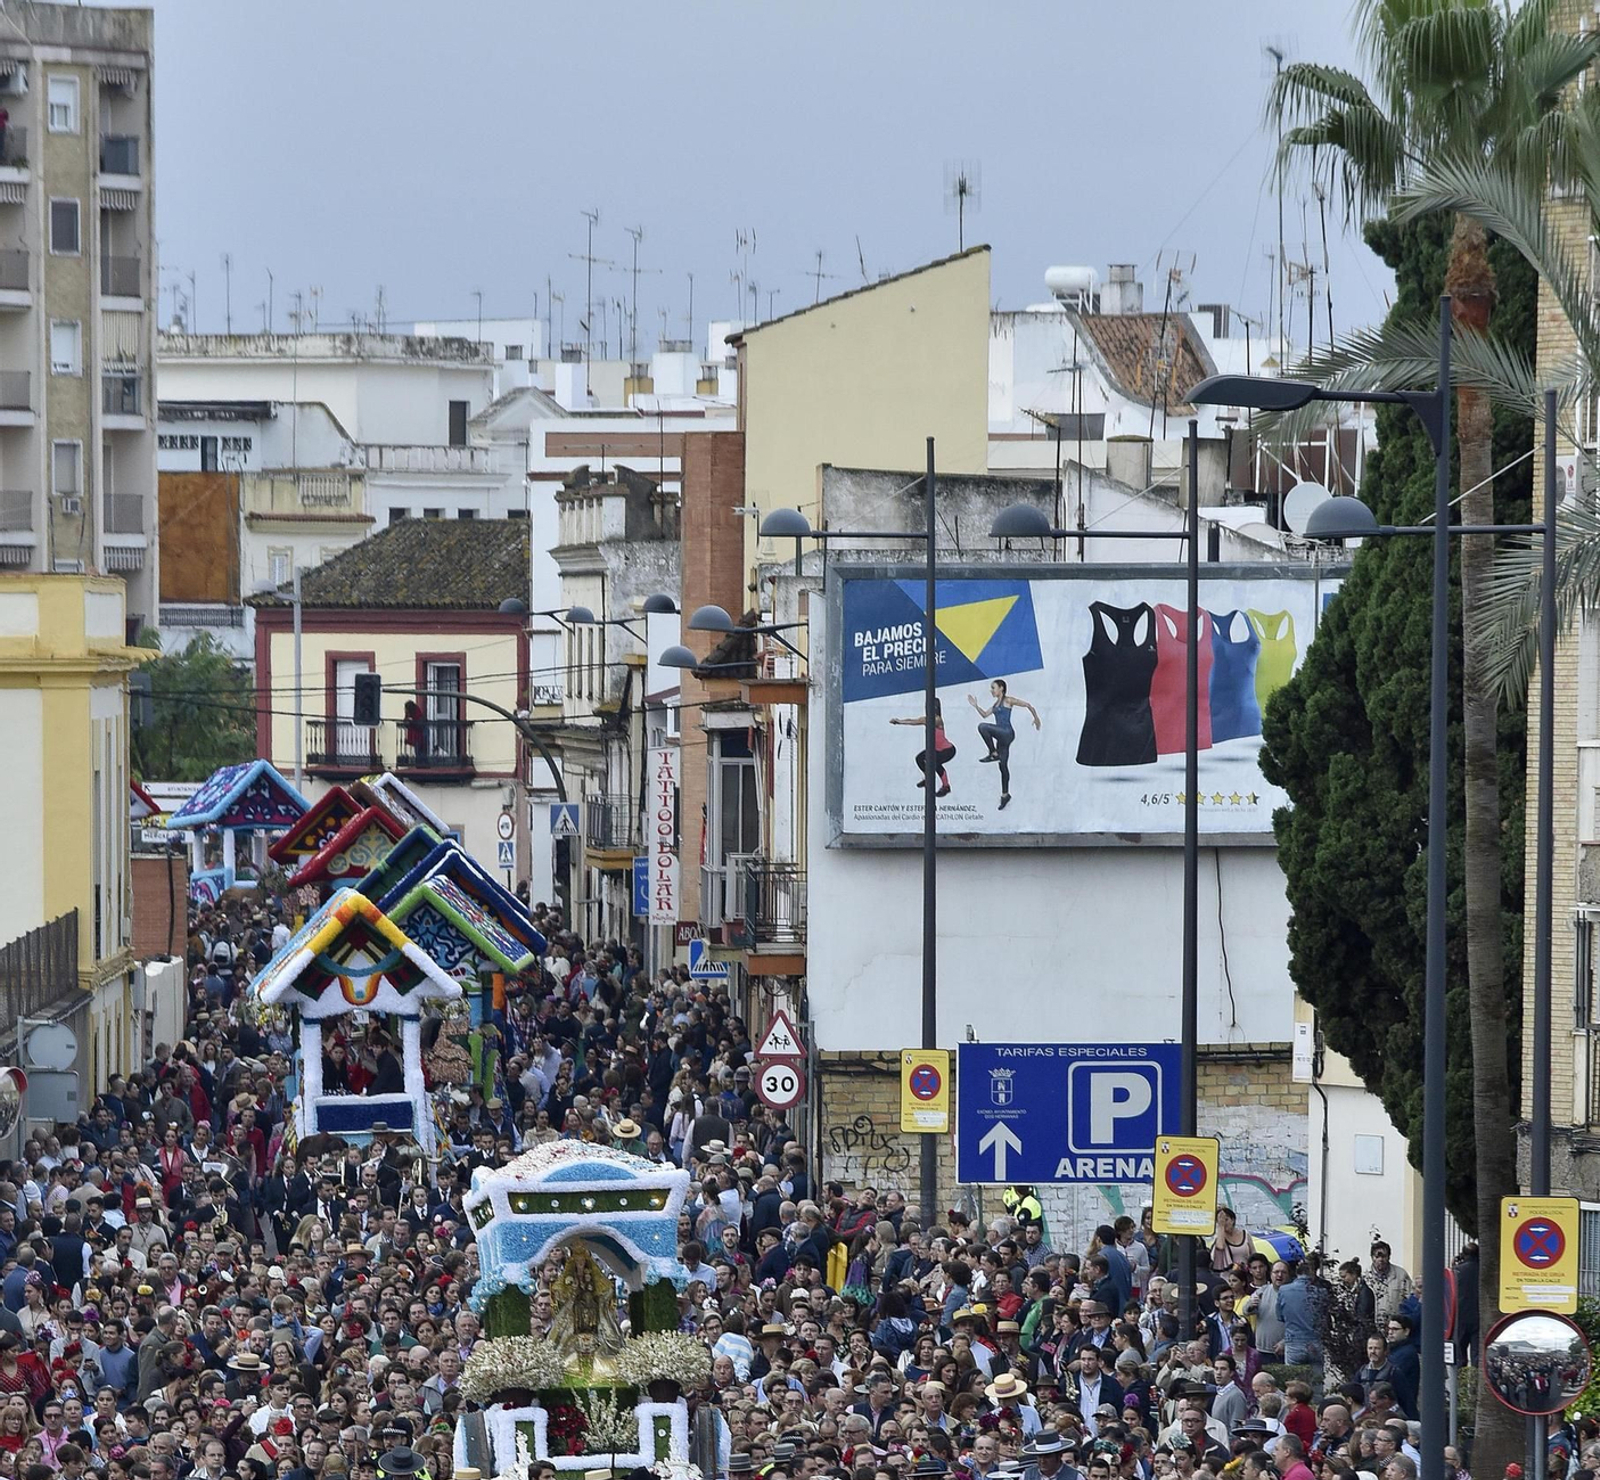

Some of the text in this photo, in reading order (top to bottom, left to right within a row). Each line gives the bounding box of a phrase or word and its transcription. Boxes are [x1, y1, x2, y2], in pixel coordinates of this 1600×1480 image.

[854, 621, 923, 648] BAJAMOS
[862, 637, 937, 662] EL PRECI
[862, 660, 893, 677] PARA
[657, 752, 673, 836] TATTOO
[853, 804, 873, 812] ESTER
[874, 803, 900, 812] CANTÓN
[901, 804, 905, 812] Y
[905, 804, 937, 812] ESTEF
[891, 813, 901, 821] del
[902, 813, 920, 821] Cardio
[995, 1047, 1148, 1057] TARIFAS ESPECIALES
[766, 1076, 794, 1093] 30
[1090, 1072, 1152, 1144] P
